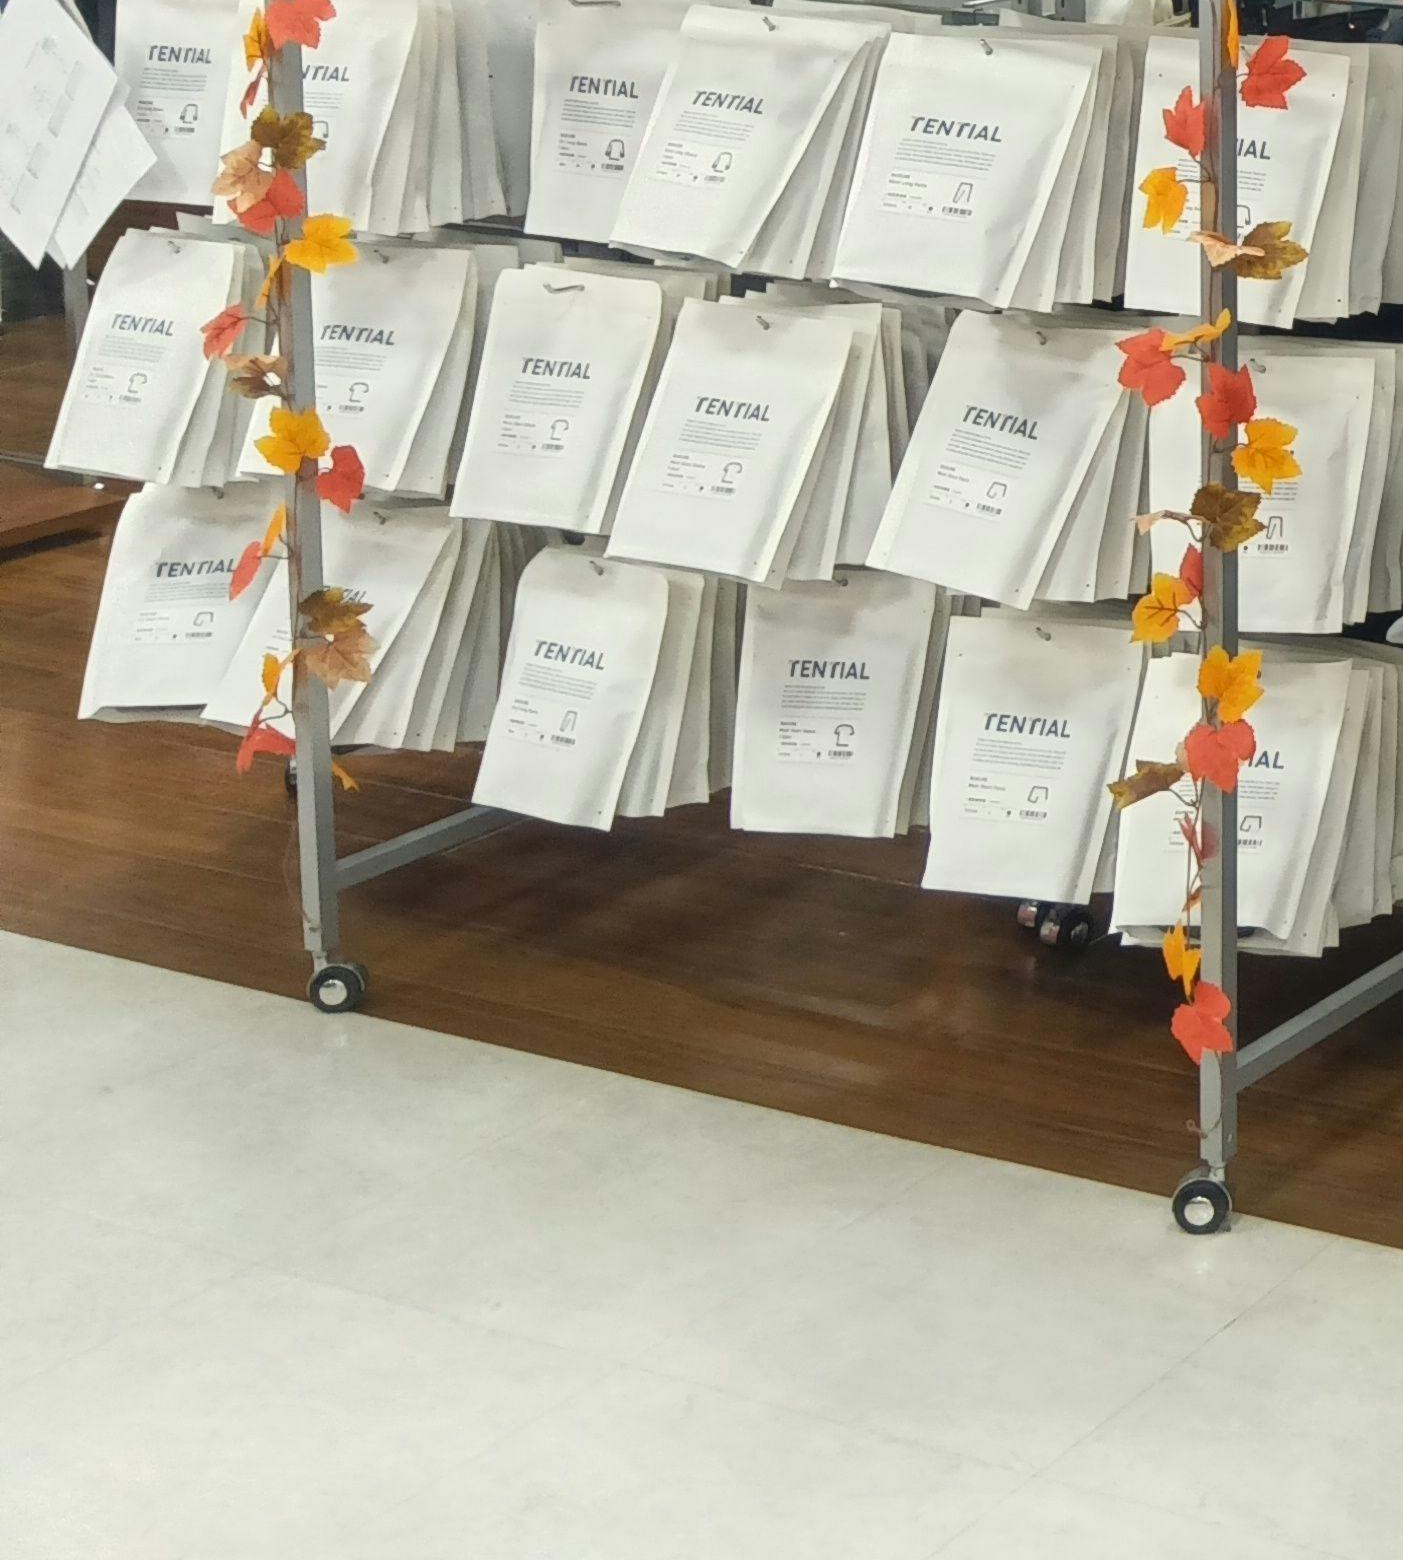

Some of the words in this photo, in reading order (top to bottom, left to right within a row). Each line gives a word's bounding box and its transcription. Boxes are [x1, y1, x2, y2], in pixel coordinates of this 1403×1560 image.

[147, 44, 213, 65] TENTIAL
[568, 74, 639, 100] TENTIAL
[691, 90, 764, 115] TENTIAL
[911, 115, 1002, 142] TENTIAL
[110, 311, 174, 337] TENTIAL
[320, 323, 395, 346] TENTIAL
[520, 357, 591, 380] TENTIAL
[693, 395, 771, 423] TENTIAL
[963, 404, 1040, 441] TENTIAL
[154, 558, 237, 578] TENTIAL
[534, 641, 606, 671] TENTIAL
[788, 659, 870, 680] TENTIAL
[982, 712, 1071, 739] TENTIAL
